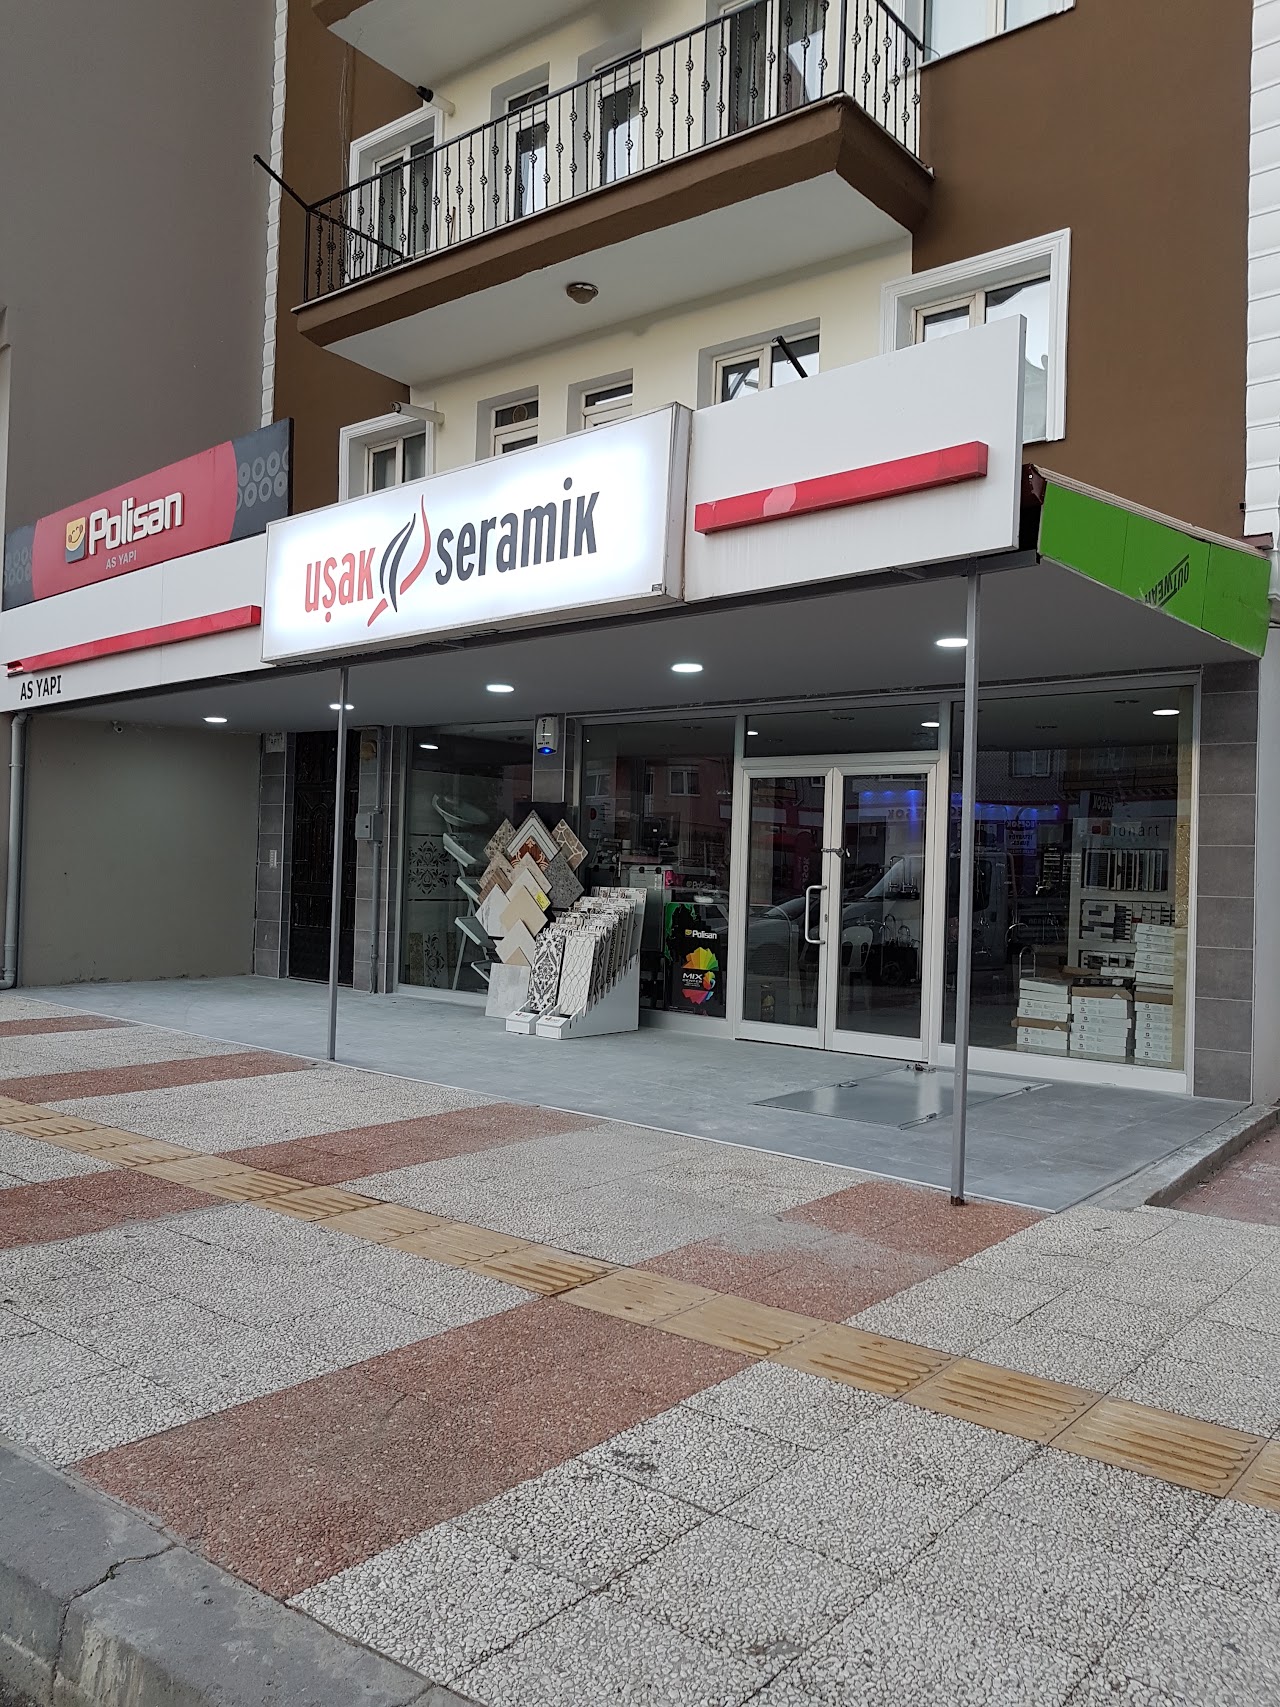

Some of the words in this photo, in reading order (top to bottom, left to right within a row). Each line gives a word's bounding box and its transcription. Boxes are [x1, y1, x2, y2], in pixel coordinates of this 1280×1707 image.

[89, 492, 184, 555] Polisan
[105, 556, 117, 570] AS
[118, 550, 137, 566] YAPI
[304, 547, 376, 623] uşak
[435, 477, 600, 585] seramik
[20, 680, 33, 701] AS
[36, 674, 62, 698] YAPI
[692, 929, 717, 939] Polisan
[682, 972, 703, 980] MIX
